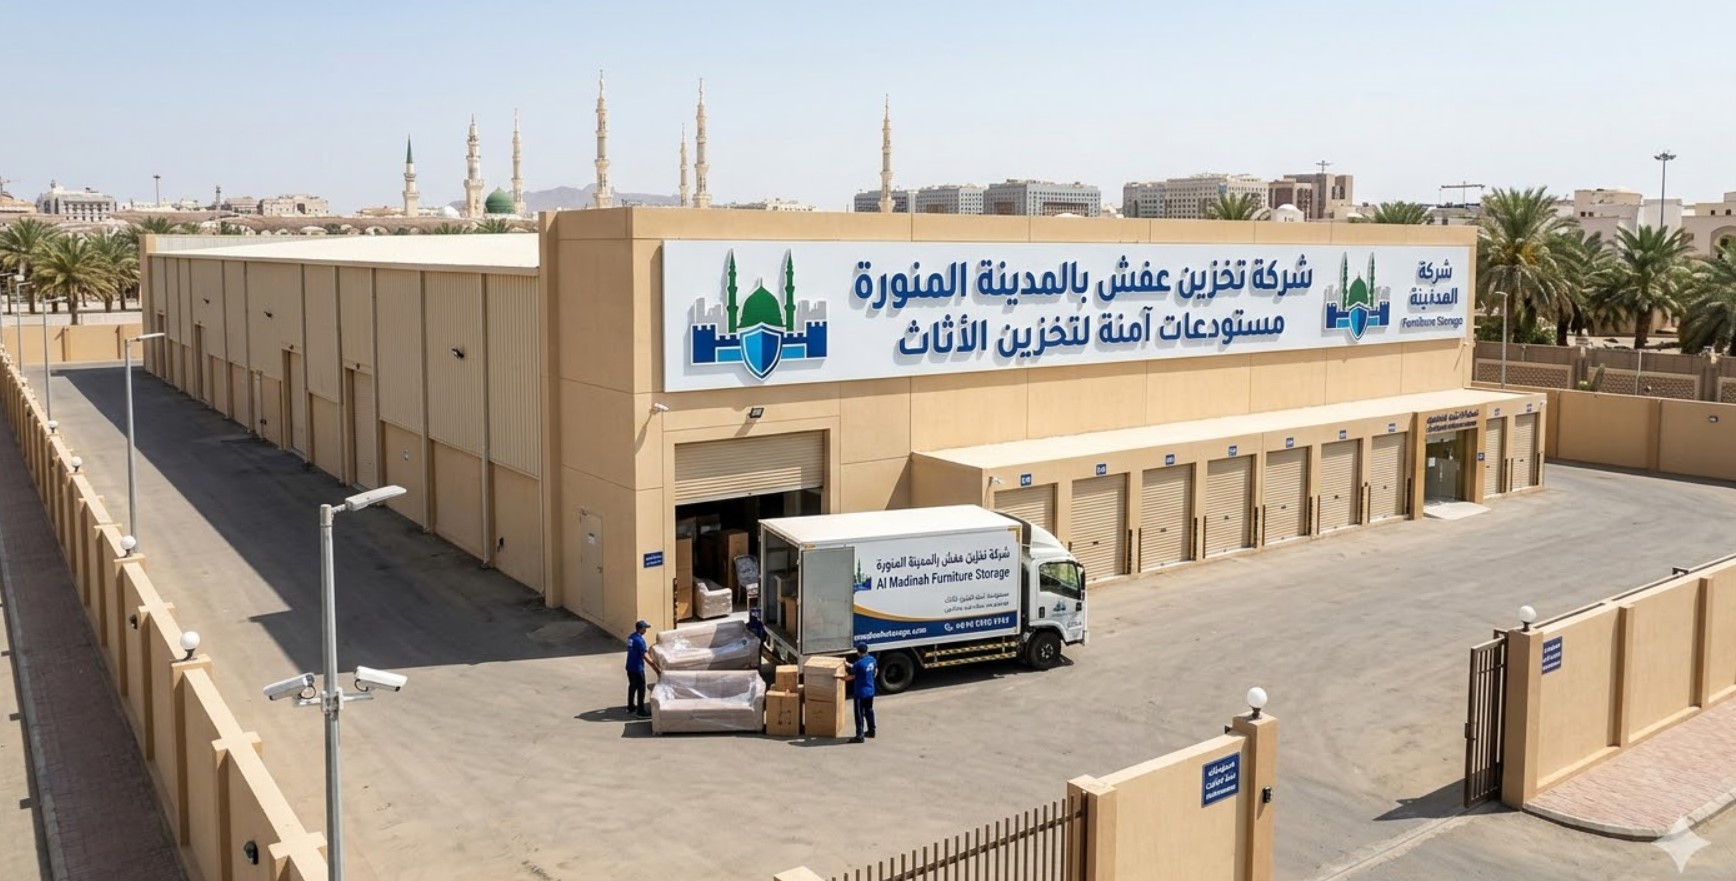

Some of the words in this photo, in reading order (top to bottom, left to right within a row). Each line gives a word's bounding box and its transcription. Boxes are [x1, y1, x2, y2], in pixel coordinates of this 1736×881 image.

[854, 261, 967, 310] المنورة
[977, 259, 1088, 306] بالمدينة
[1098, 255, 1171, 302] عفش
[1178, 259, 1246, 300] تخزين
[1252, 254, 1313, 298] شركة
[1418, 259, 1452, 284] شركة
[899, 314, 987, 355] الأثاث
[997, 315, 1090, 359] لتخزين
[1098, 306, 1153, 344] آمنة
[1159, 309, 1285, 345] مستودعات
[876, 577, 887, 590] Al
[889, 573, 929, 588] Madinah
[931, 570, 973, 584] Furniture
[975, 568, 1010, 581] Storage
